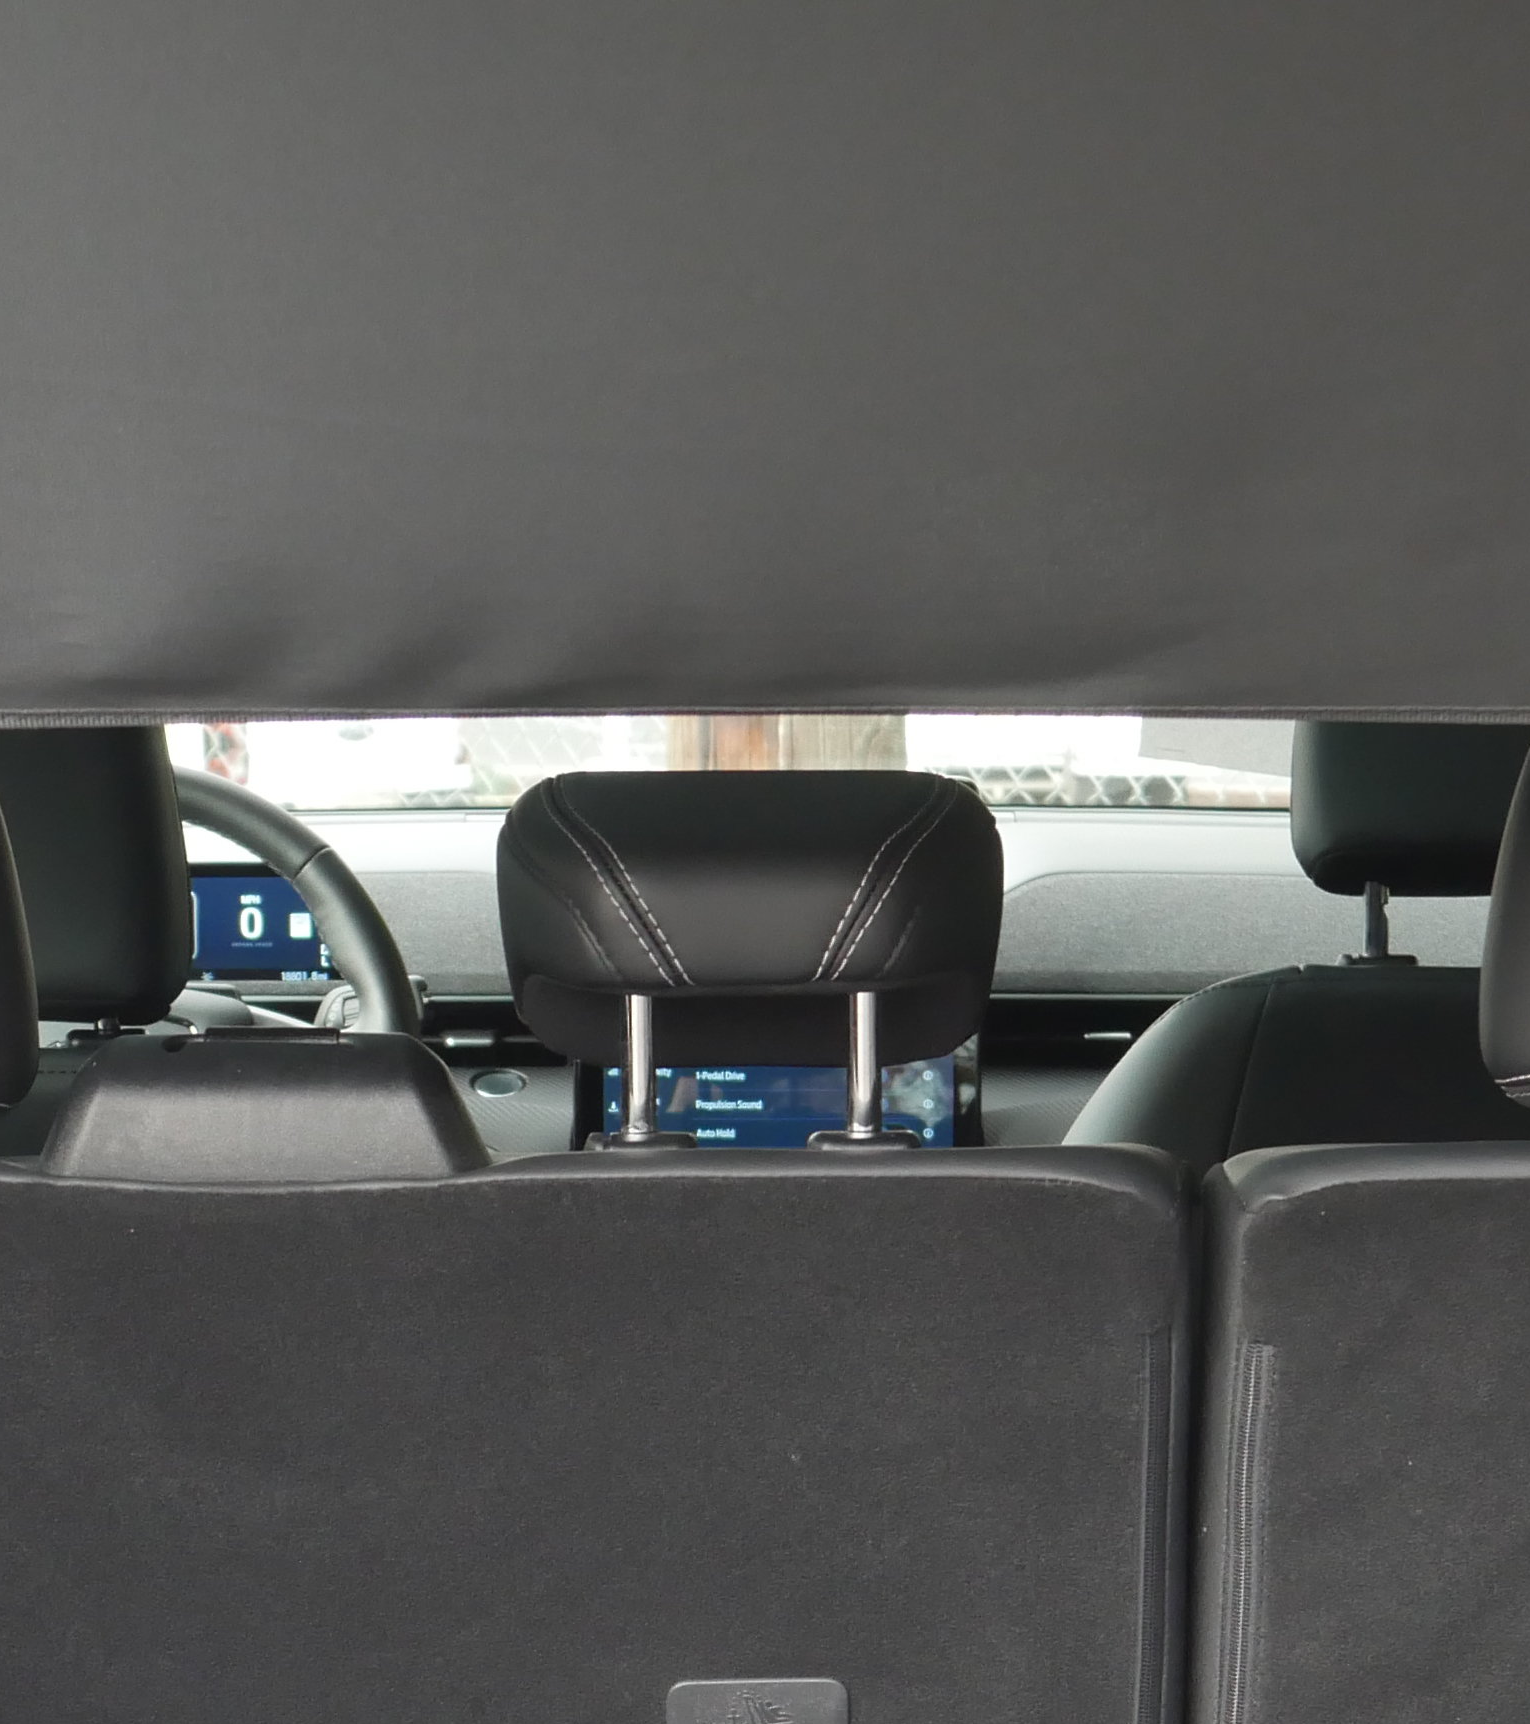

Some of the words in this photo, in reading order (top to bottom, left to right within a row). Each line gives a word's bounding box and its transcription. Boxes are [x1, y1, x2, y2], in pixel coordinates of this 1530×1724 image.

[240, 894, 262, 905] MPH
[240, 906, 264, 939] 0
[725, 1071, 746, 1081] Drive
[695, 1099, 736, 1111] Propulsion
[737, 1099, 763, 1110] Sound
[696, 1128, 715, 1138] Auto
[716, 1128, 736, 1138] Hold
